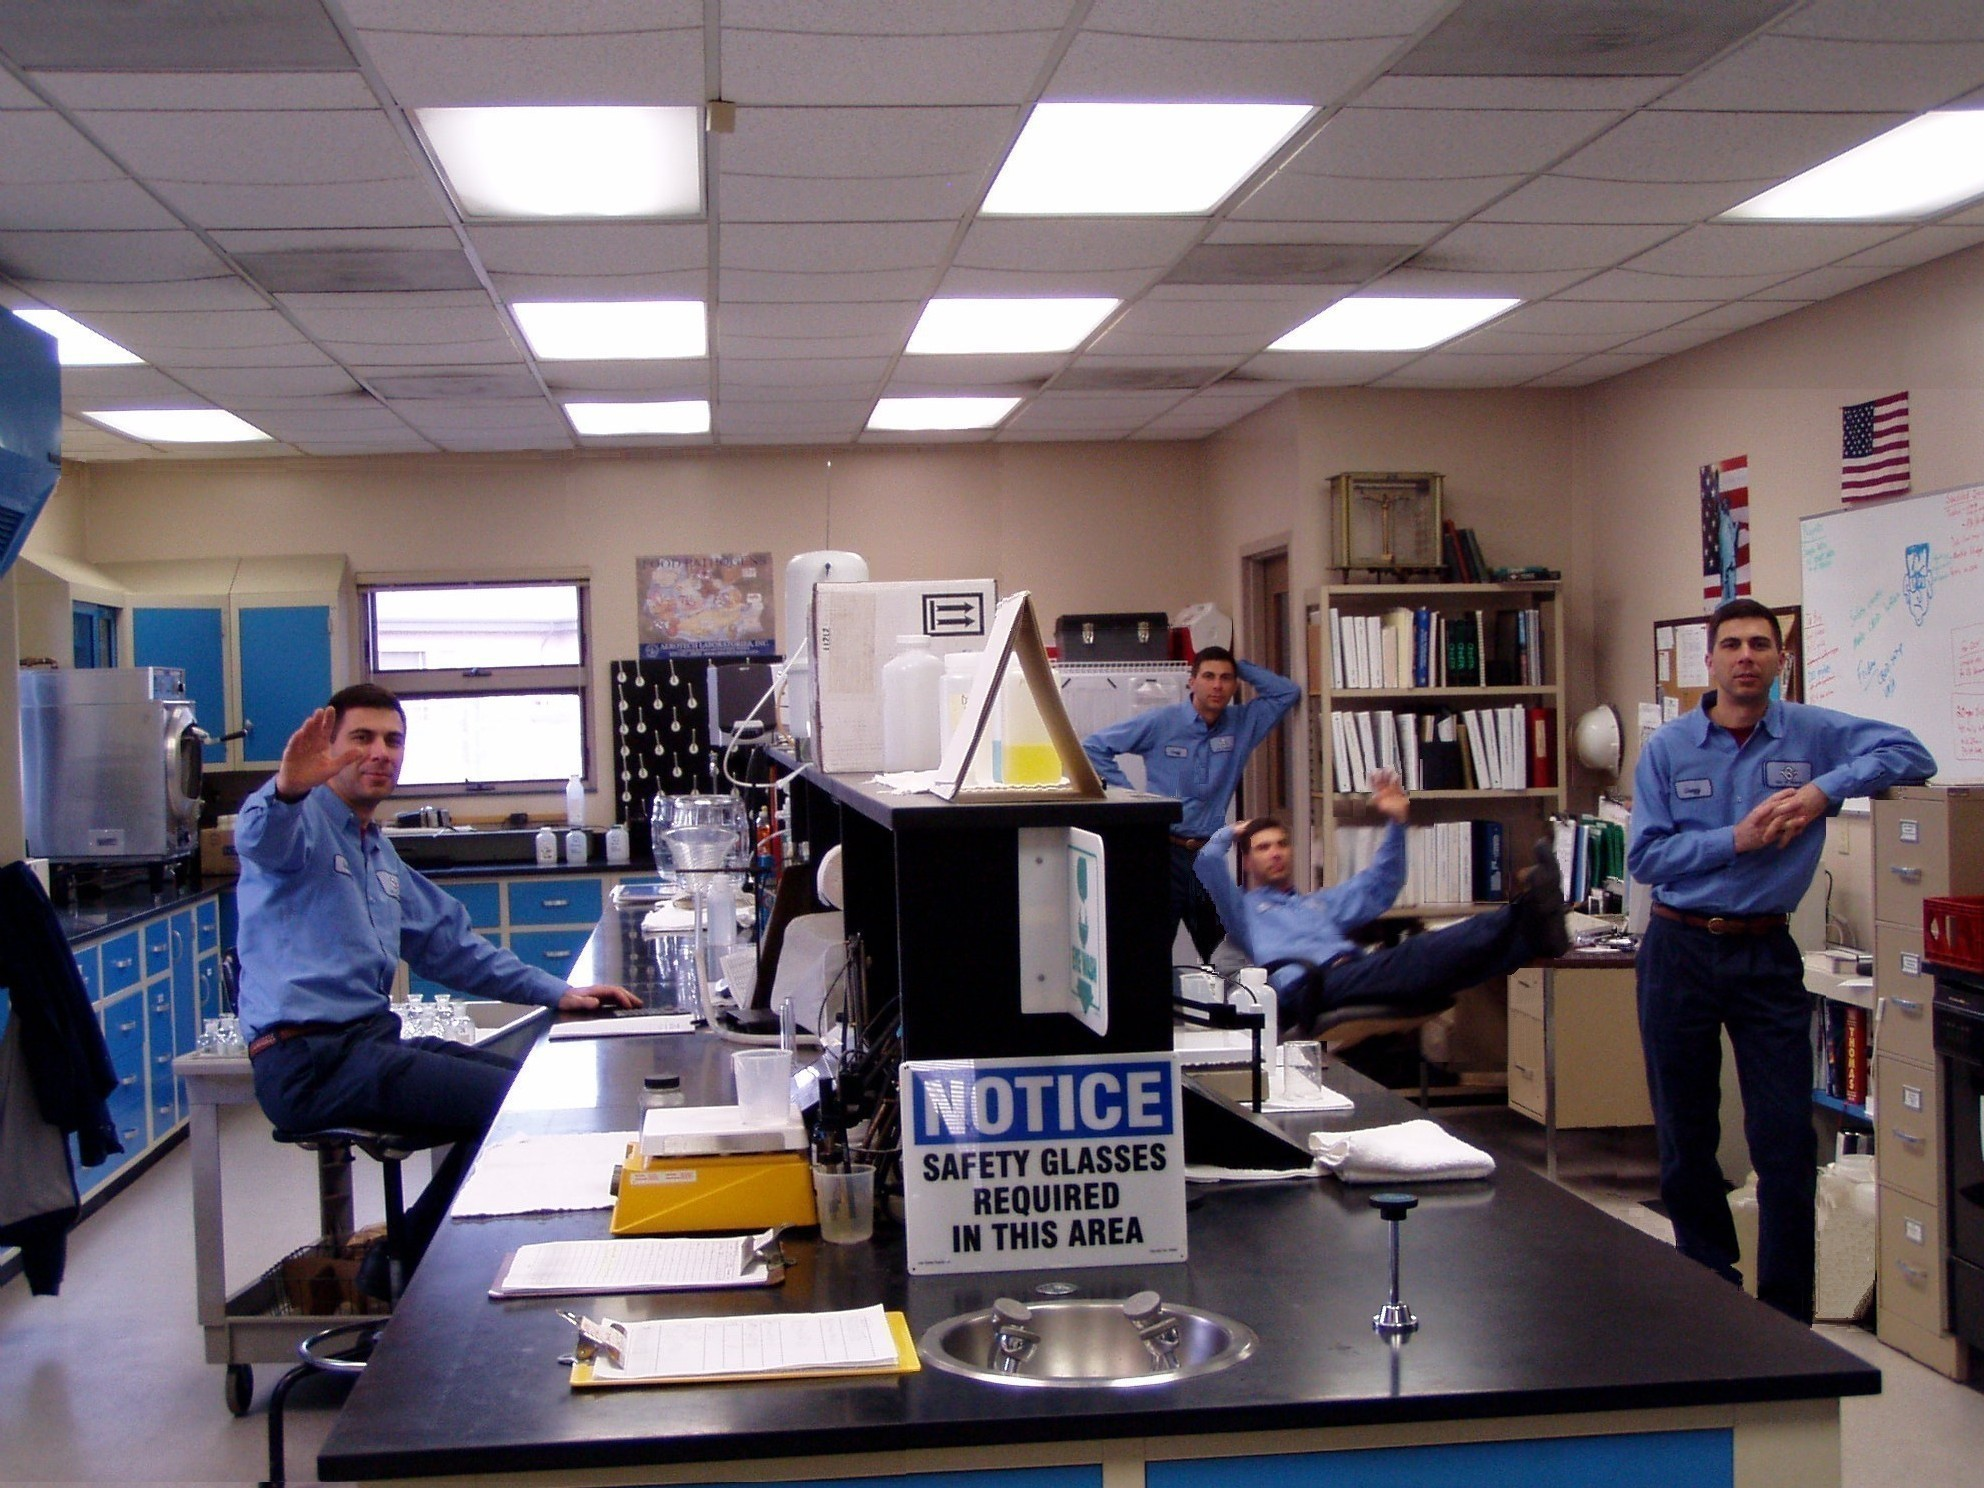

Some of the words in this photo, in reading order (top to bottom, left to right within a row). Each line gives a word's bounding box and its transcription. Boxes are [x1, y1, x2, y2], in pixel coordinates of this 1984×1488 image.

[642, 558, 681, 569] FOOD
[1072, 945, 1081, 974] EYE
[1848, 1027, 1856, 1090] THOMAS
[924, 1072, 1164, 1137] NOTICE
[923, 1149, 1030, 1181] SAFETY
[1041, 1143, 1167, 1176] GLASSES
[974, 1182, 1119, 1217] REQUIRED
[953, 1225, 981, 1253] IN
[992, 1220, 1057, 1250] THIS
[1069, 1217, 1144, 1247] AREA
